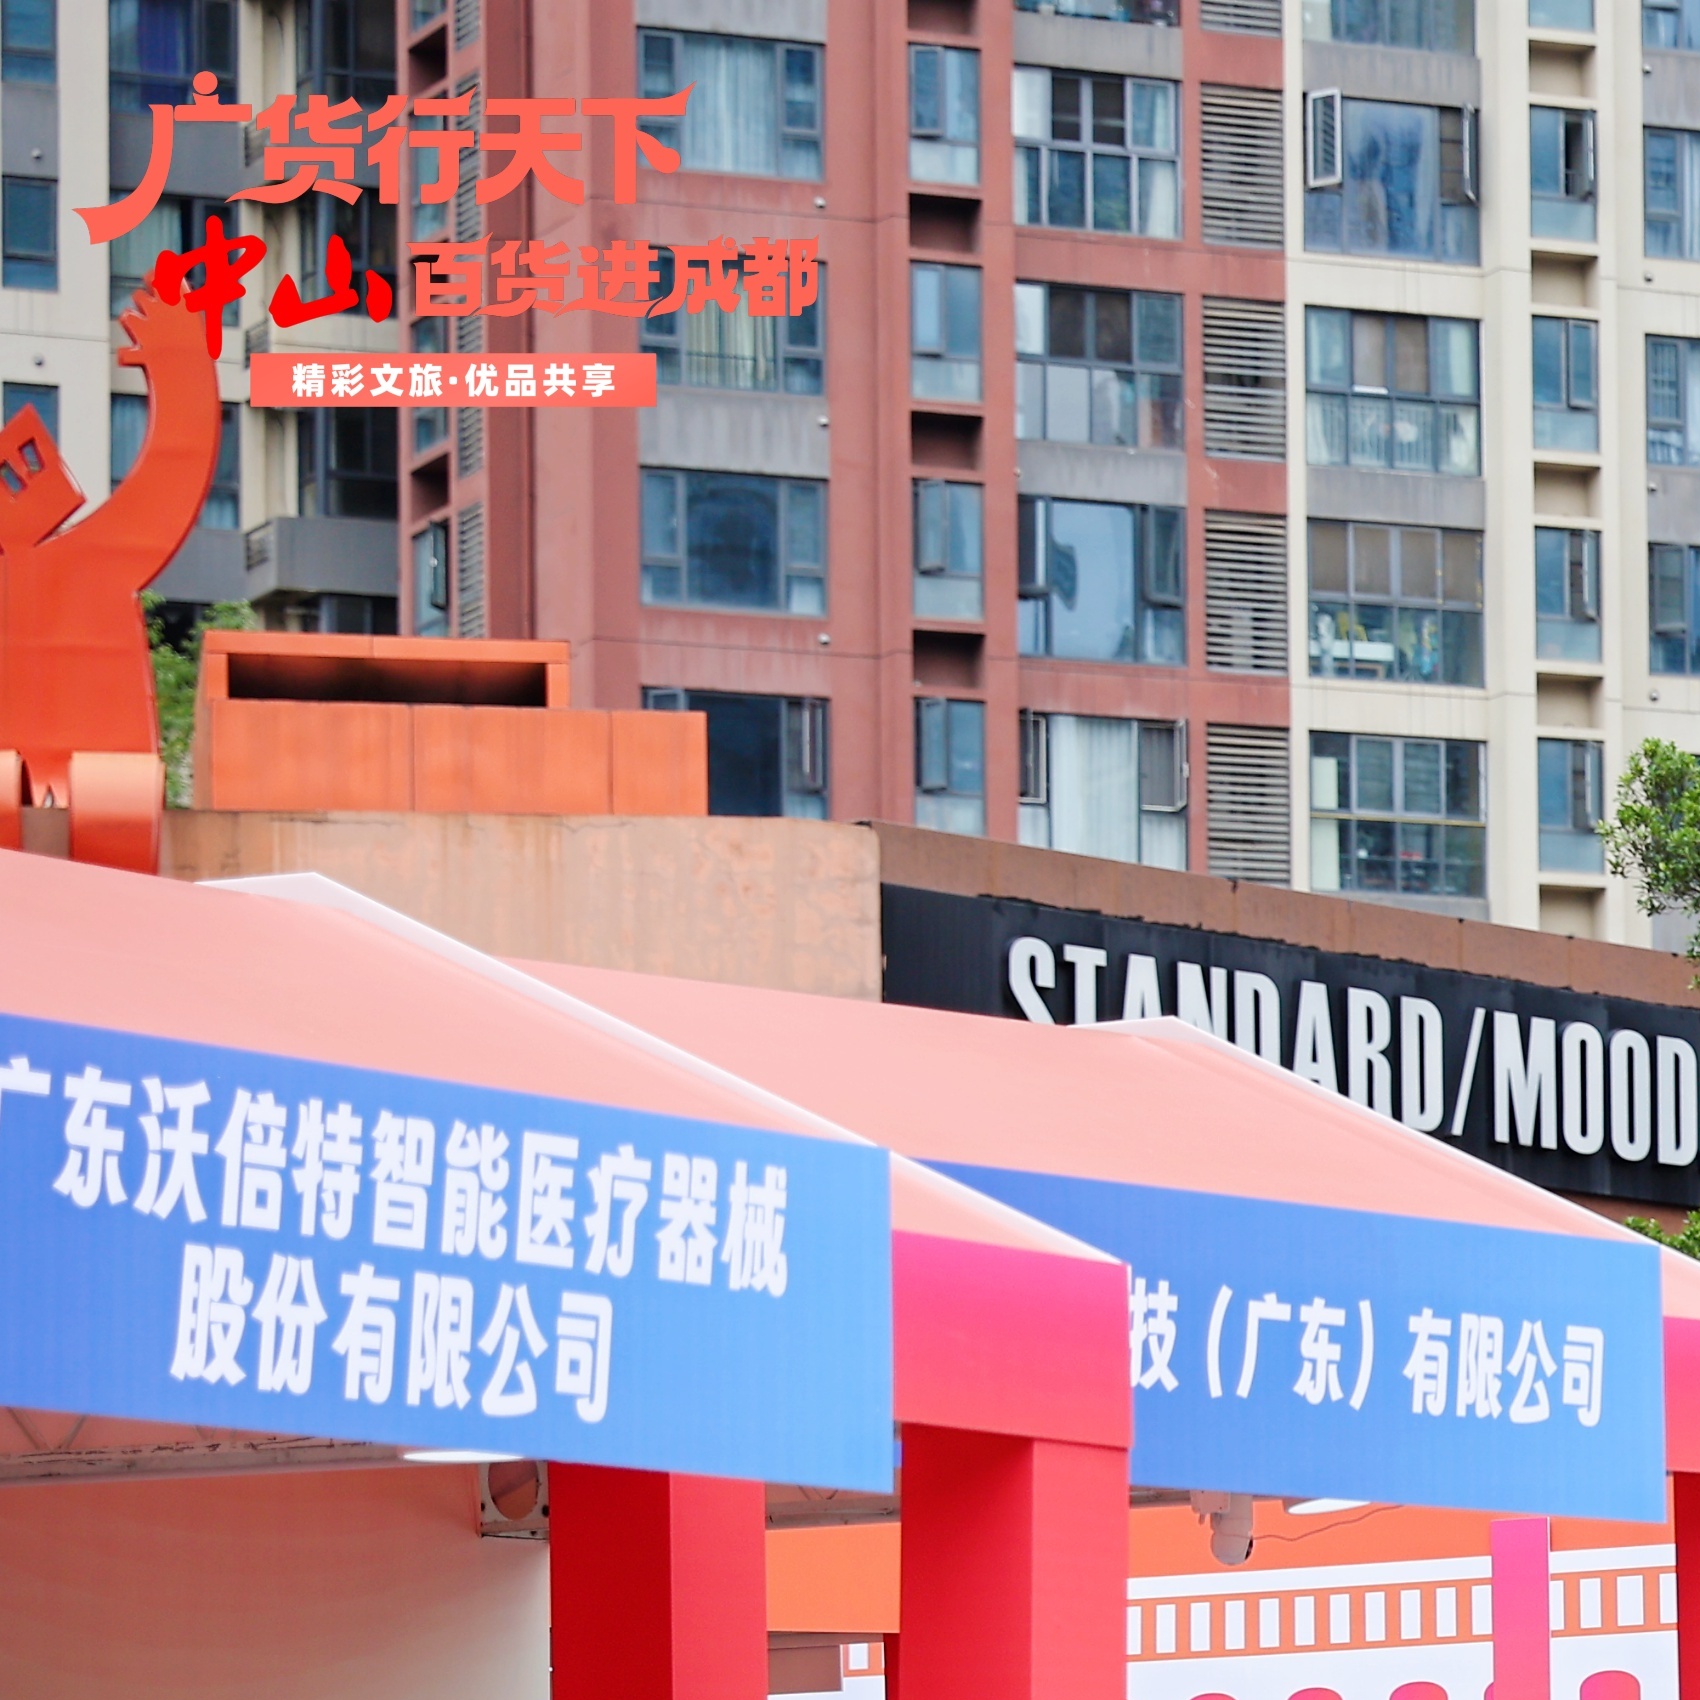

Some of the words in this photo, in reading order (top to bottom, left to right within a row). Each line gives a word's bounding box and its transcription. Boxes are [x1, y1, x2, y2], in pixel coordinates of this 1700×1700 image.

[170, 1243, 613, 1424] 股份有限公司
